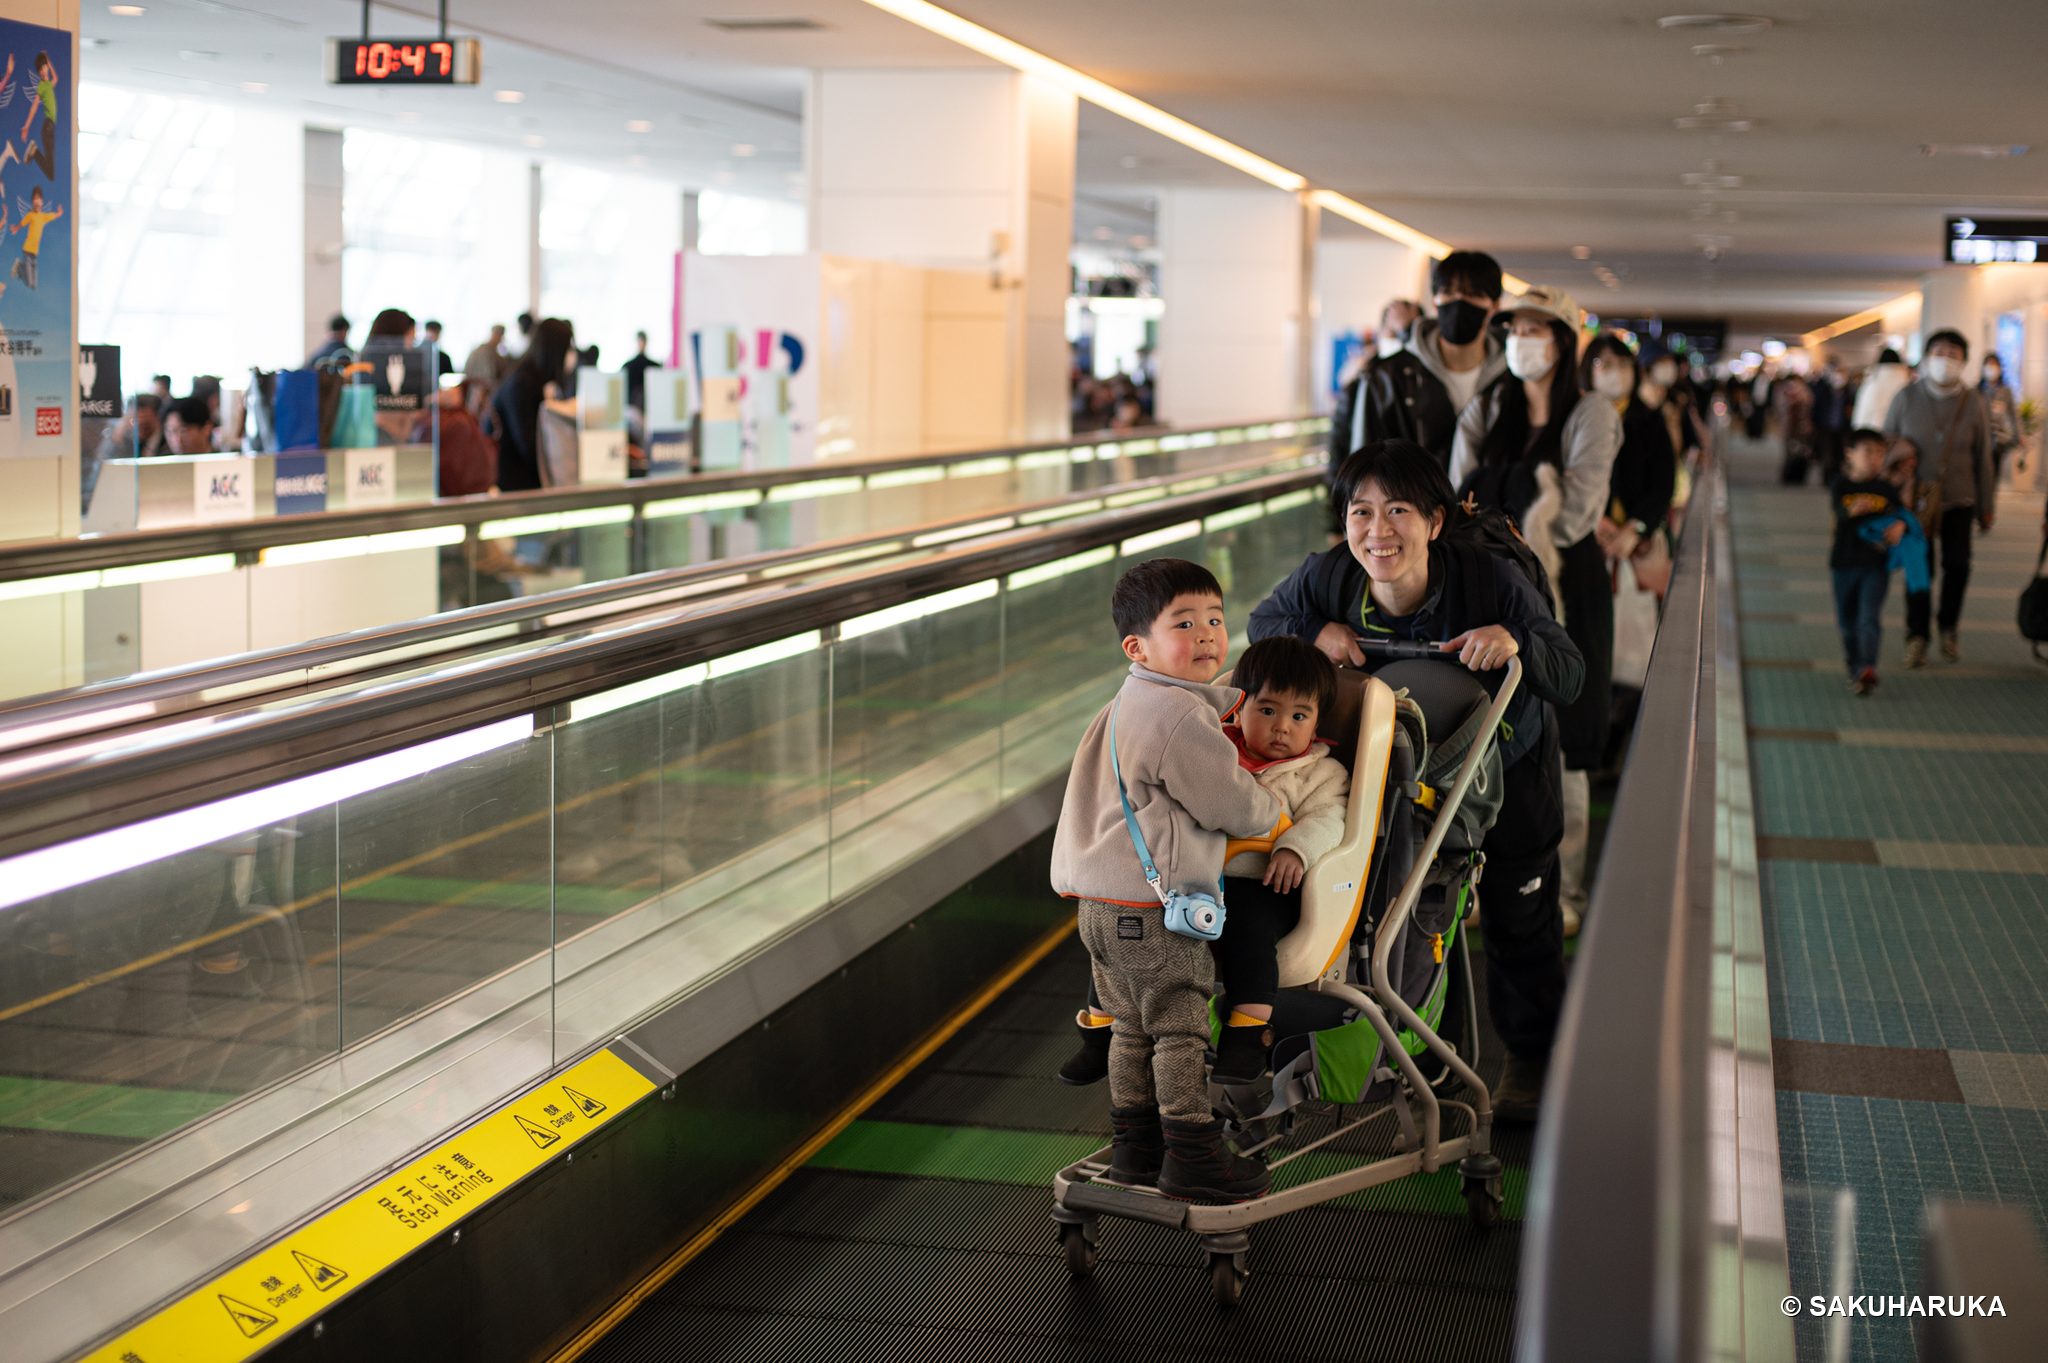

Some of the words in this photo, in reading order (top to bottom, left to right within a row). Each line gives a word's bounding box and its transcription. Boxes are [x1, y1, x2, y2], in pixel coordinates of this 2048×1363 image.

[355, 42, 452, 78] 10:47
[80, 400, 113, 415] ARGE
[210, 474, 240, 498] AGC
[550, 1111, 576, 1128] Danger
[377, 1153, 476, 1216] 足元に注意
[398, 1203, 439, 1229] Step
[430, 1169, 494, 1207] Warning
[267, 1284, 303, 1307] Danger
